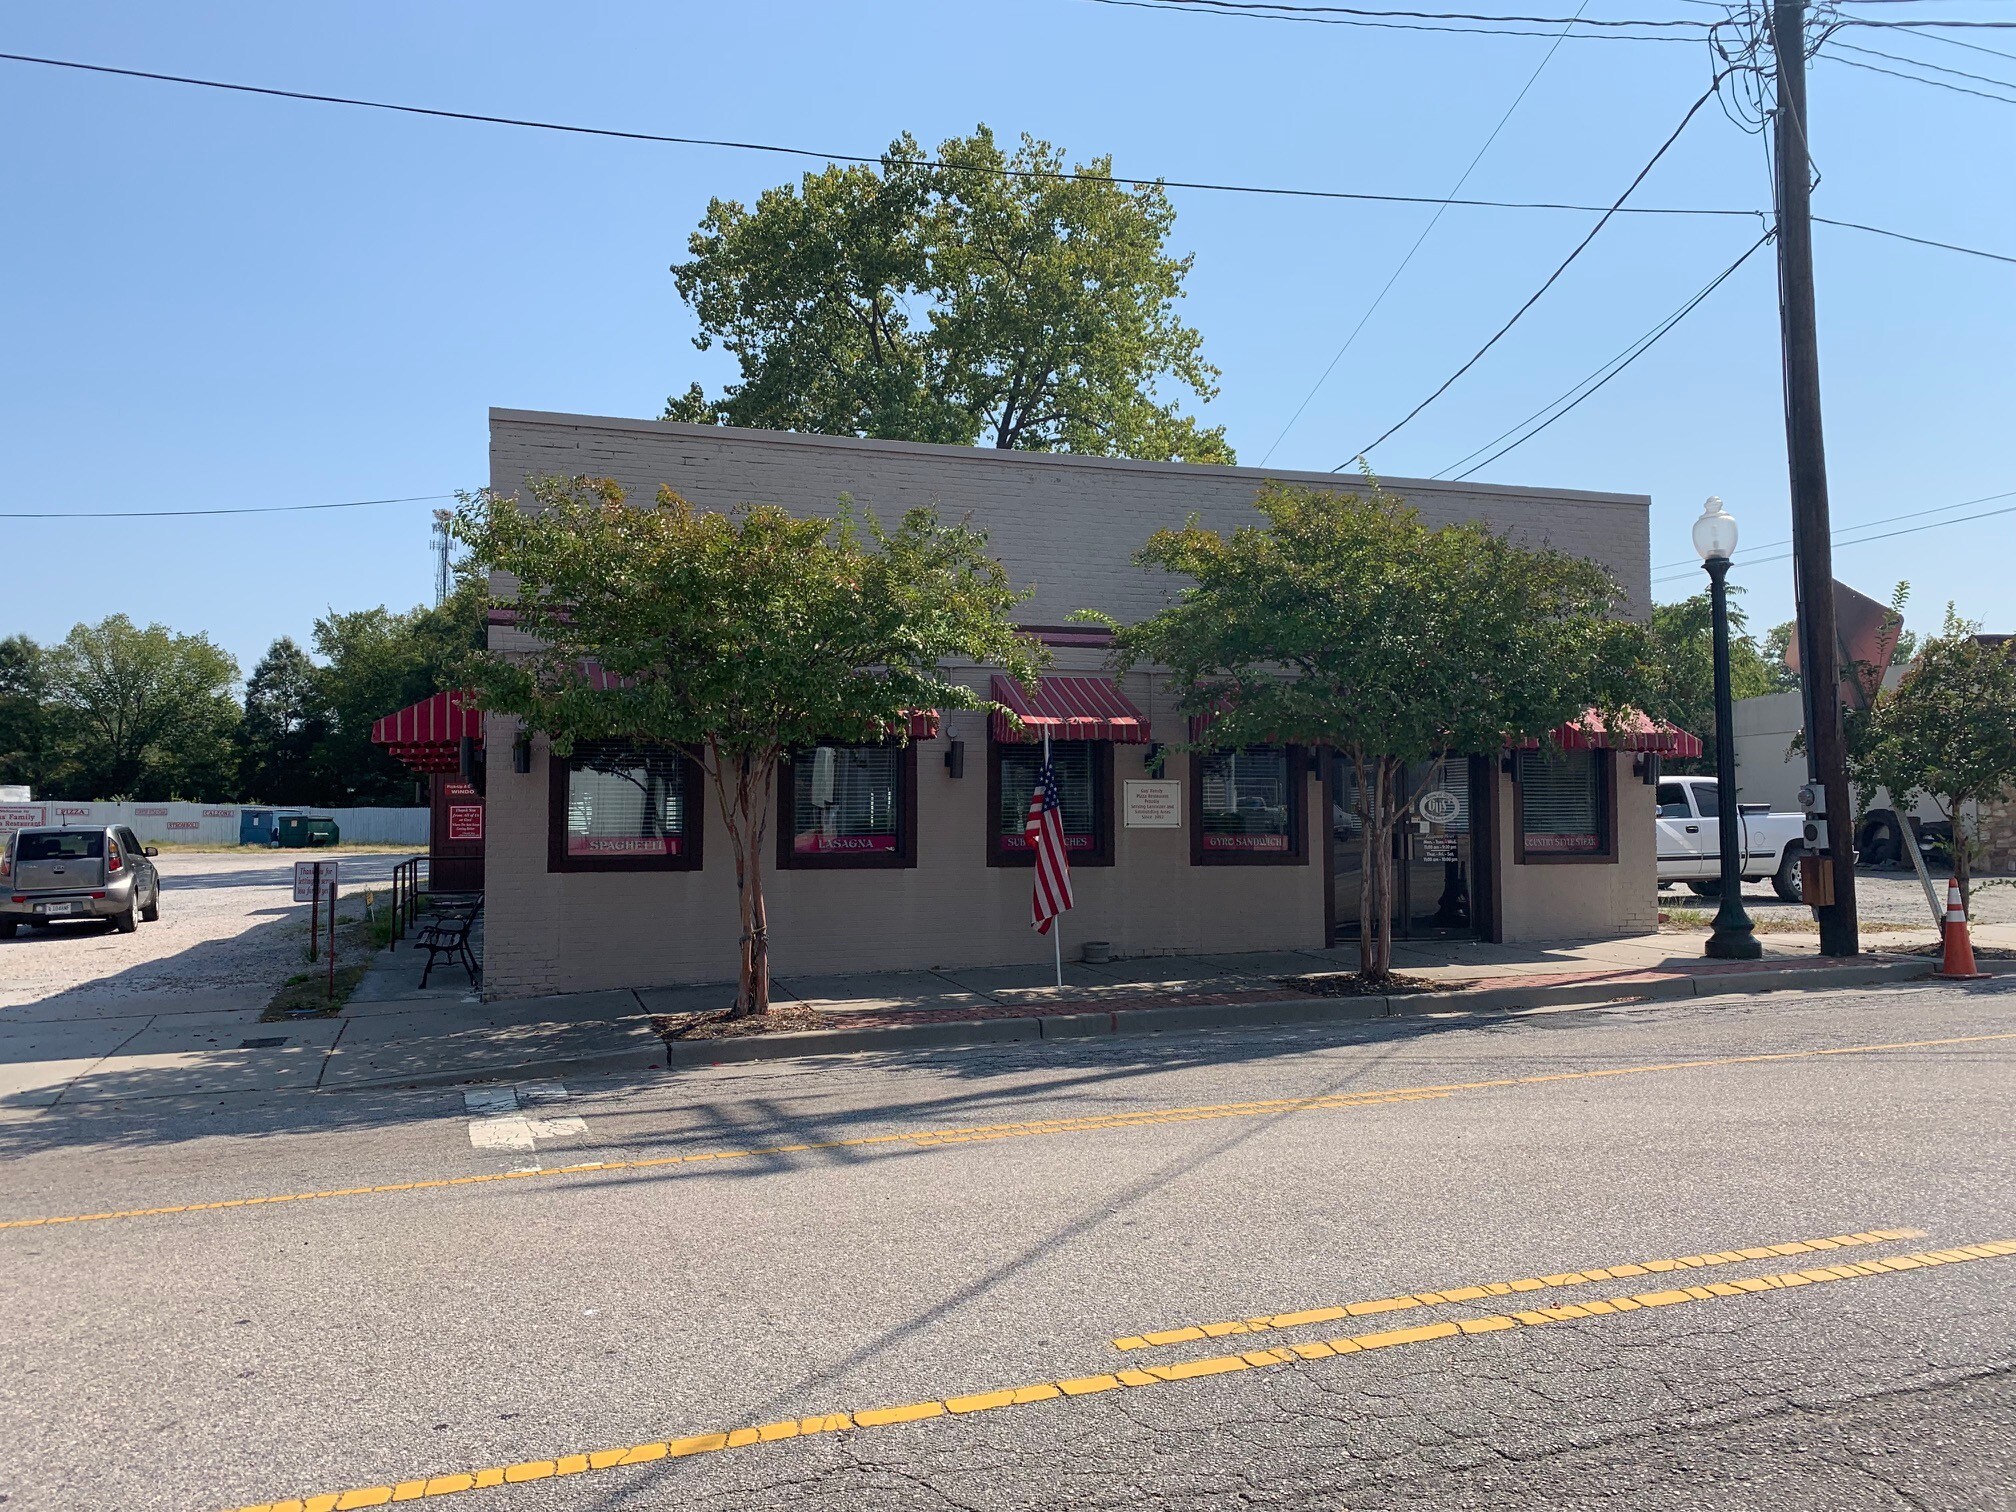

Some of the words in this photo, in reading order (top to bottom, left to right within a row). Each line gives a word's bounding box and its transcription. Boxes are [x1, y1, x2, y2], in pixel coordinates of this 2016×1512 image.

[589, 840, 662, 851] SPAGHETTI
[818, 838, 874, 849] LASAGNA
[1209, 837, 1234, 846] GYRO
[1235, 837, 1282, 846] SANDWICH
[1525, 838, 1554, 847] COUNTRY
[1554, 838, 1575, 847] STYLE
